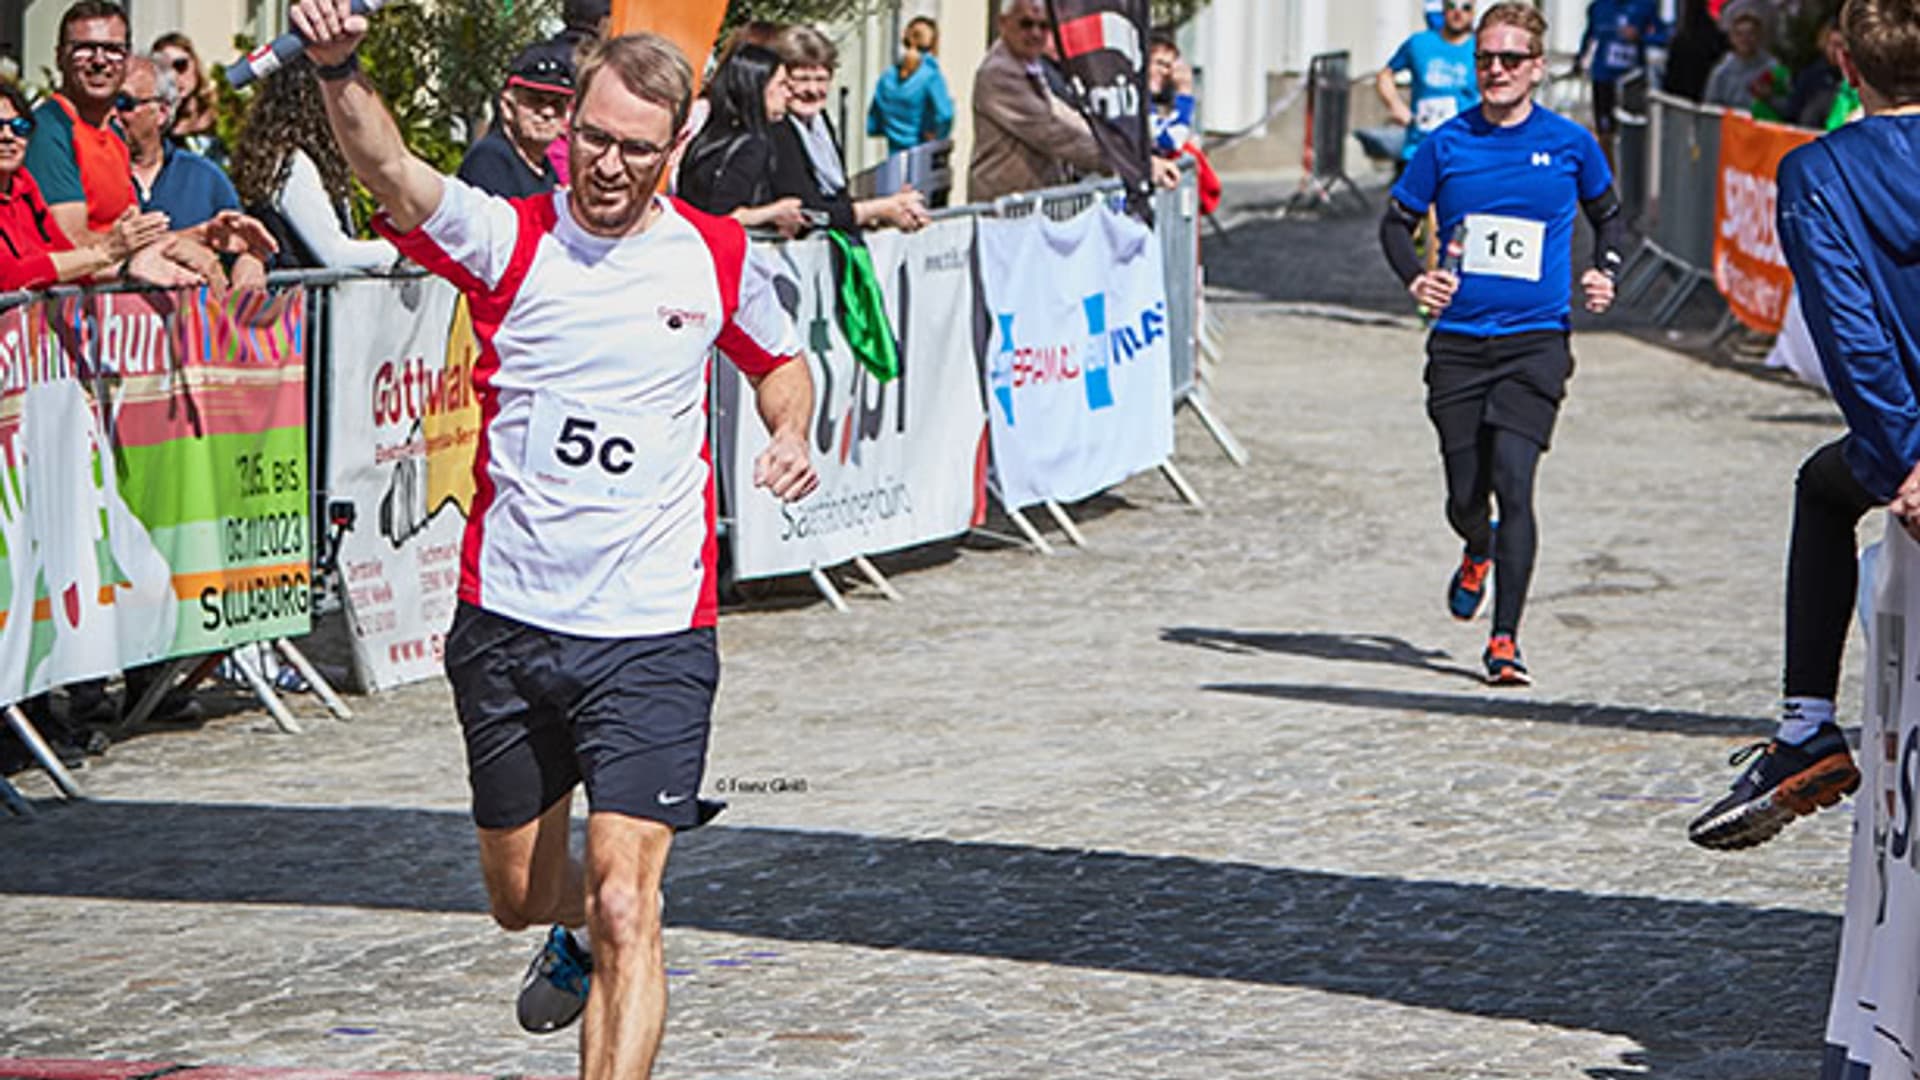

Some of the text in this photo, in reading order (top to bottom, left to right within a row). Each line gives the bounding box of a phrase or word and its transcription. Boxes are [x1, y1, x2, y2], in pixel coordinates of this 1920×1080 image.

[1485, 231, 1524, 260] 1c
[373, 346, 470, 427] Gottwal
[555, 416, 636, 475] 5c
[272, 458, 301, 493] BIS
